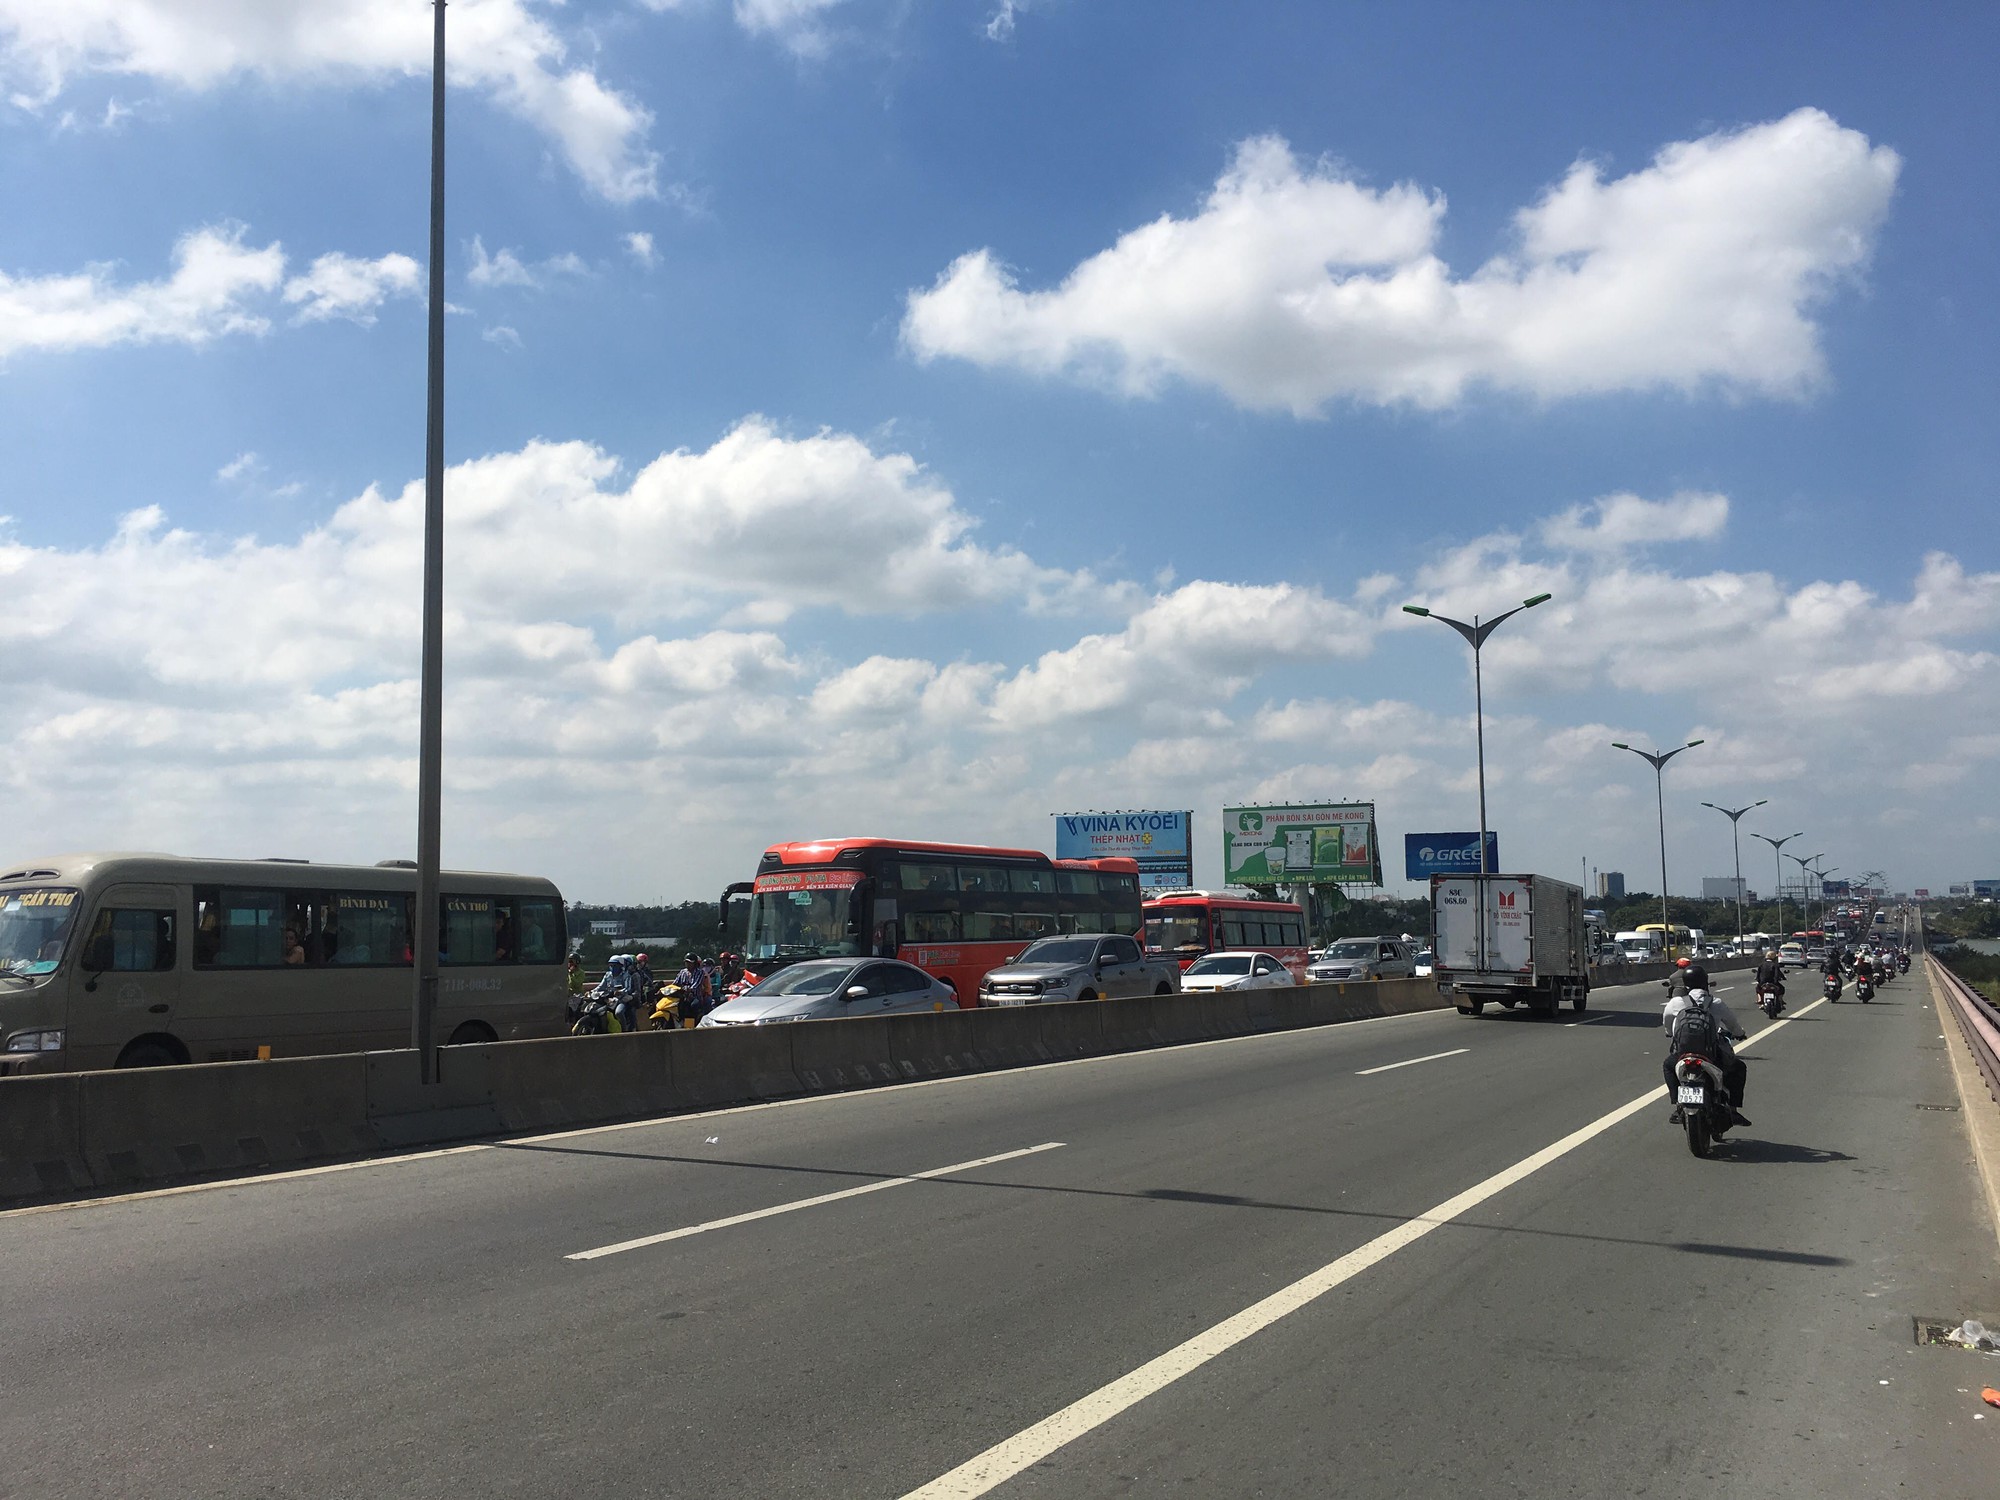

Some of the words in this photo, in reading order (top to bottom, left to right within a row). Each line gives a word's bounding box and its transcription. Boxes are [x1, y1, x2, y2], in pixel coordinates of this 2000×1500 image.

[1081, 816, 1120, 832] VINA
[1126, 814, 1178, 831] KYOEI
[1090, 834, 1113, 844] THÉP
[1116, 834, 1140, 845] NHẬT
[1437, 849, 1481, 861] GREE
[340, 896, 367, 909] BÌNH
[469, 901, 489, 911] THƠ
